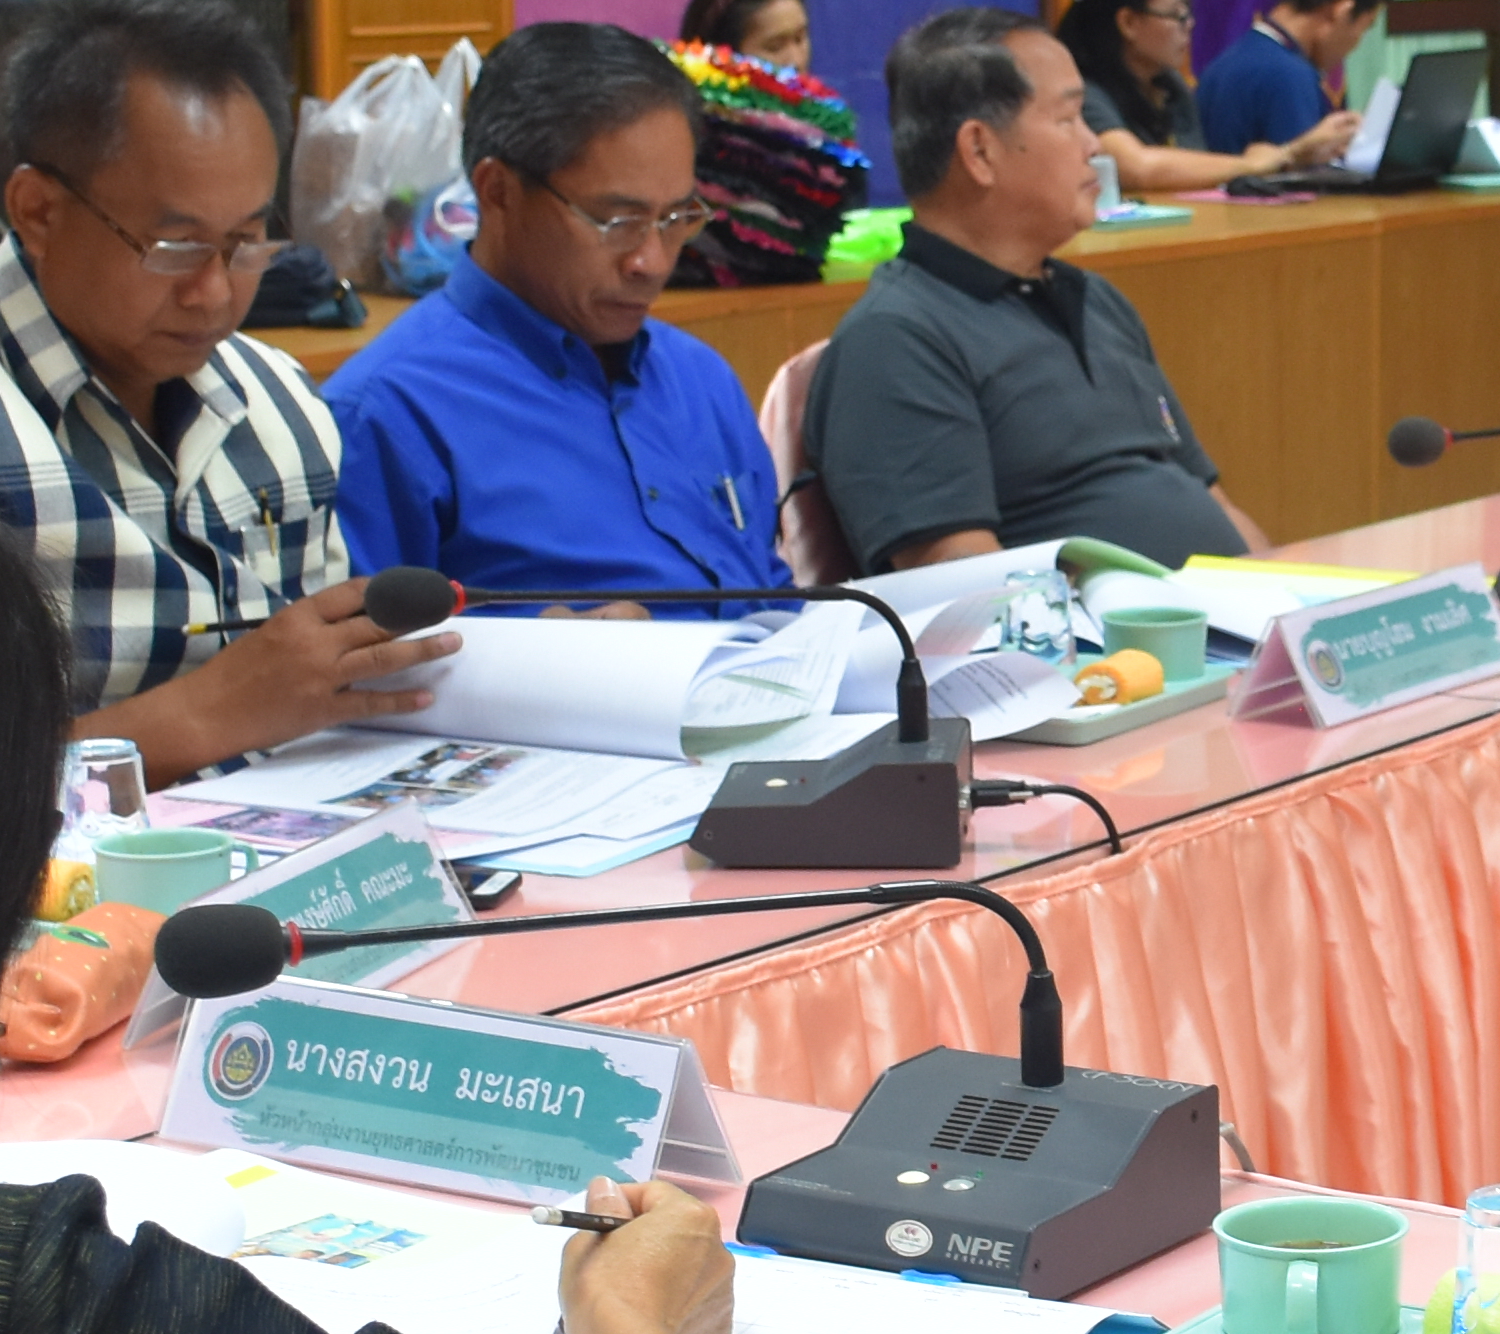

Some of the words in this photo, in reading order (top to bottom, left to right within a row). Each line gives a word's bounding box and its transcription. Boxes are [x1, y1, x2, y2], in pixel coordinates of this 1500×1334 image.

[282, 867, 357, 929] พงษ์ศักดิ์
[286, 1038, 431, 1094] นางสงวน
[455, 1066, 586, 1119] มะเสนา
[946, 1232, 1015, 1263] NPE
